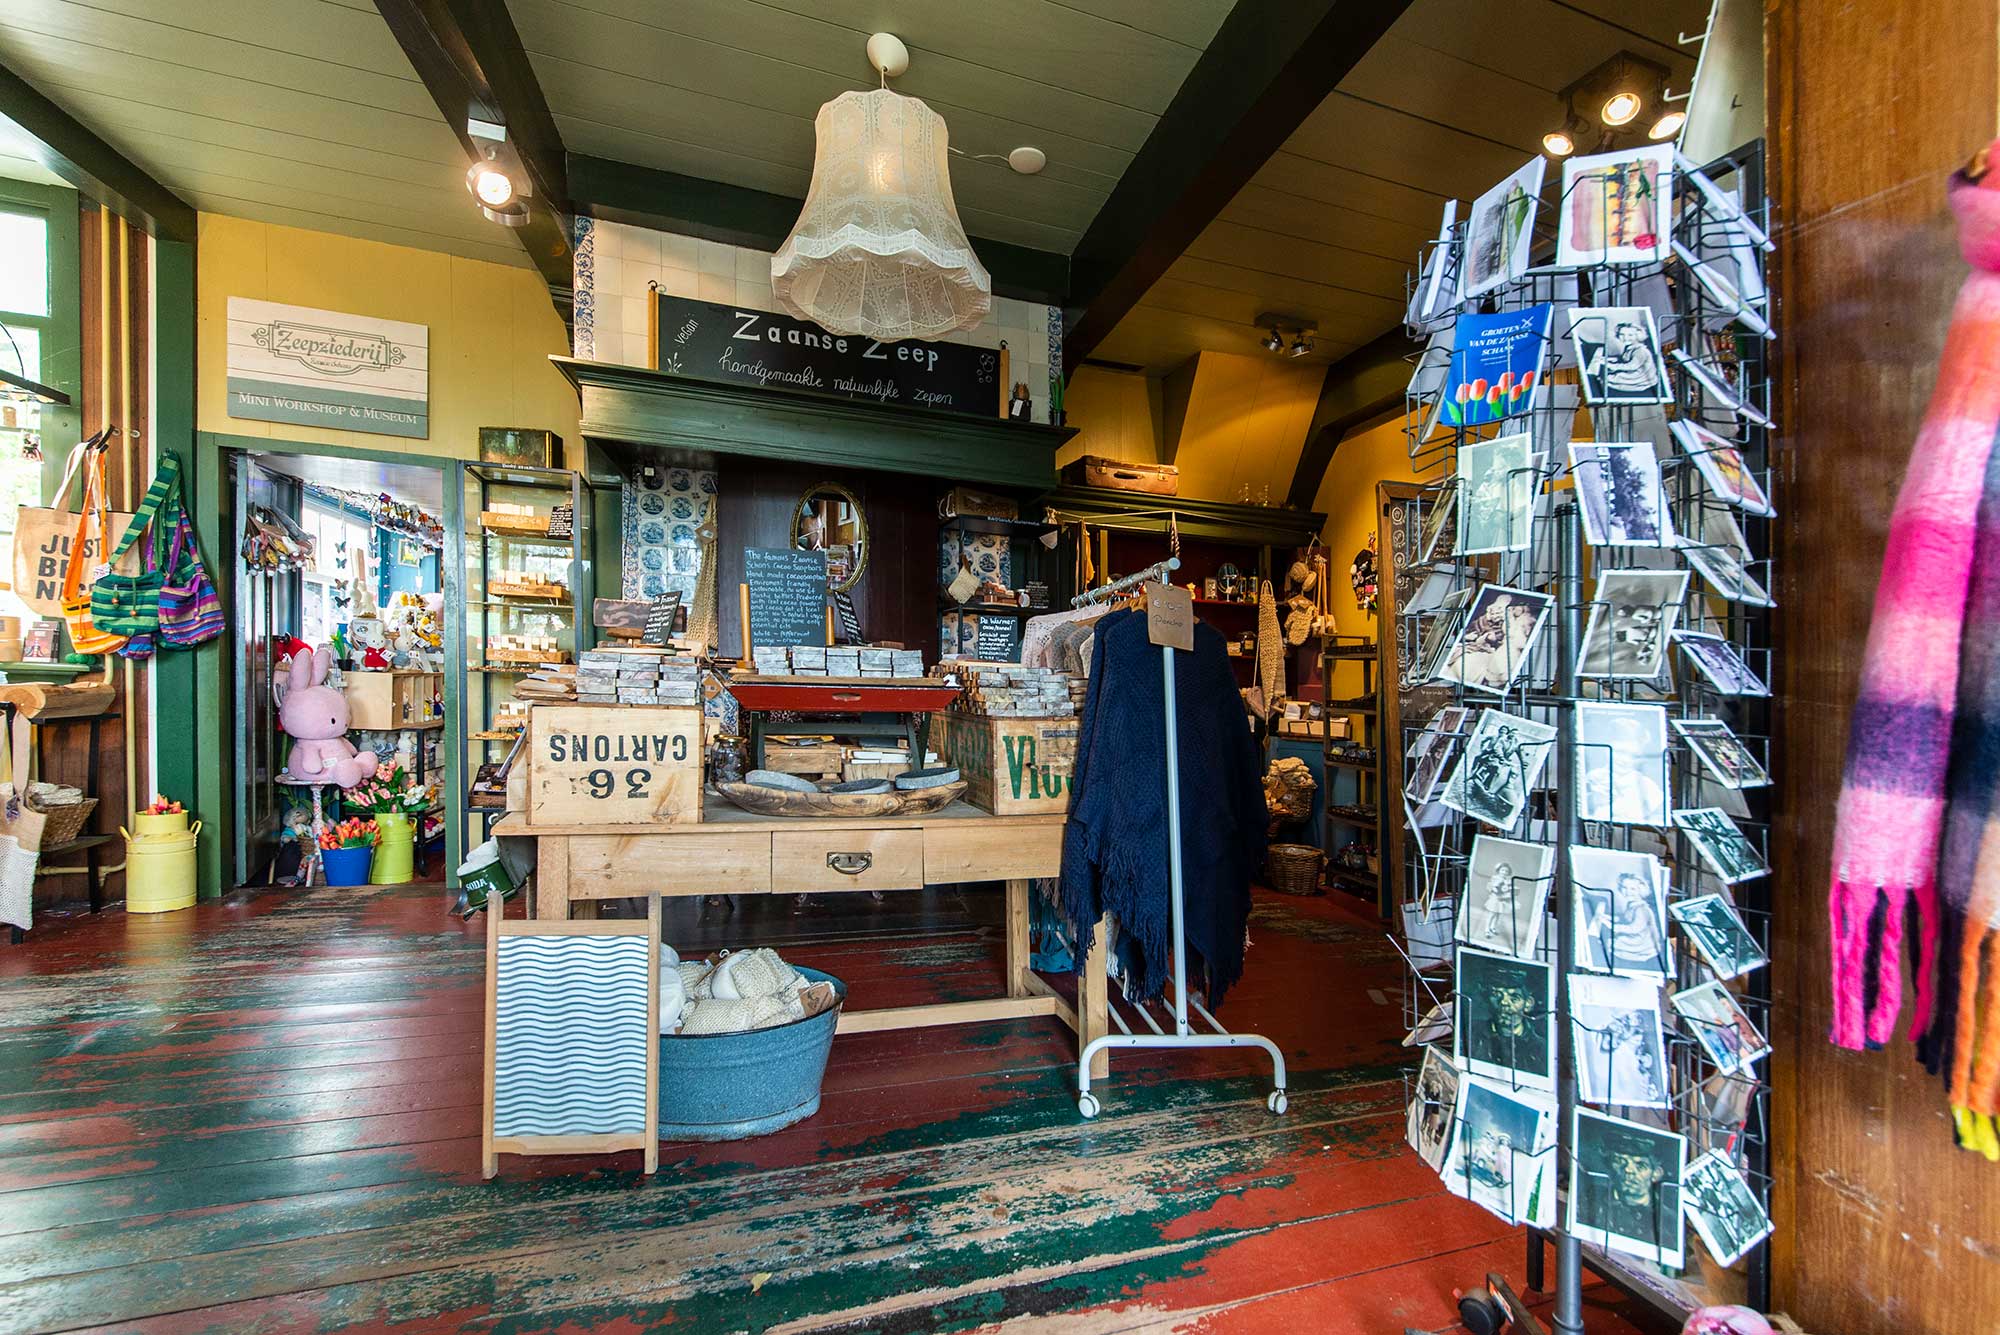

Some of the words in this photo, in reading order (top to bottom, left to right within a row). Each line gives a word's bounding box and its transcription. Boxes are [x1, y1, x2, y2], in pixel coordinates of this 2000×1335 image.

[1481, 325, 1520, 337] GROETEN
[276, 330, 382, 365] Zeepziederij
[732, 312, 848, 353] Zaanse
[862, 335, 939, 372] Zeep
[1469, 339, 1486, 347] VAN
[1486, 338, 1499, 346] DE
[718, 345, 824, 388] handgemaakte
[833, 376, 900, 403] natuurlijke
[349, 405, 361, 418] &
[745, 550, 761, 560] The
[764, 552, 789, 562] famous
[746, 570, 764, 578] Hand
[767, 571, 785, 579] made
[550, 734, 688, 762] CARTONS
[1002, 735, 1073, 800] VI
[588, 768, 652, 799] 36
[465, 877, 488, 892] SODA
